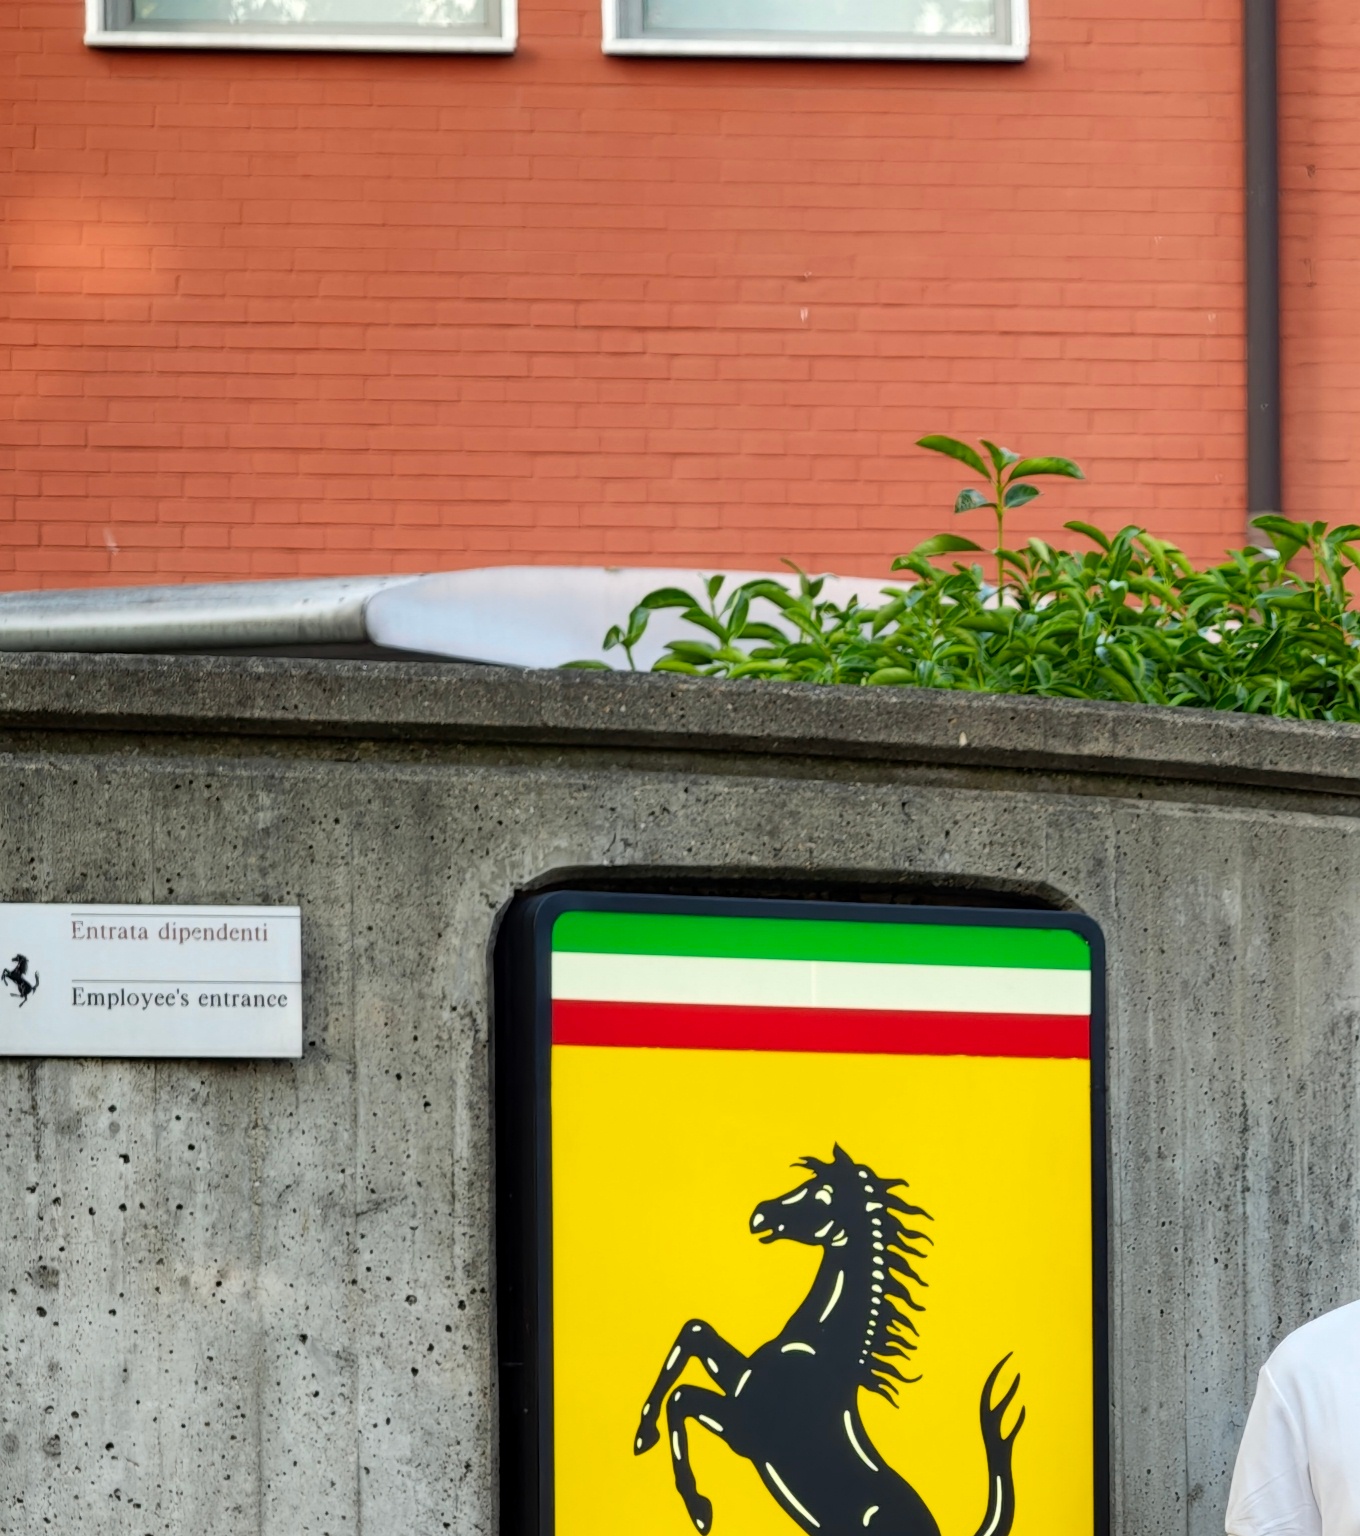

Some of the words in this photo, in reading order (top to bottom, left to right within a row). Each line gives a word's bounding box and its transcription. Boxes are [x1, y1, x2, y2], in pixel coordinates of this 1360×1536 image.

[71, 920, 149, 940] Entrata
[158, 922, 269, 945] dipendenti
[71, 986, 190, 1011] Employee's
[198, 991, 288, 1008] entrance
